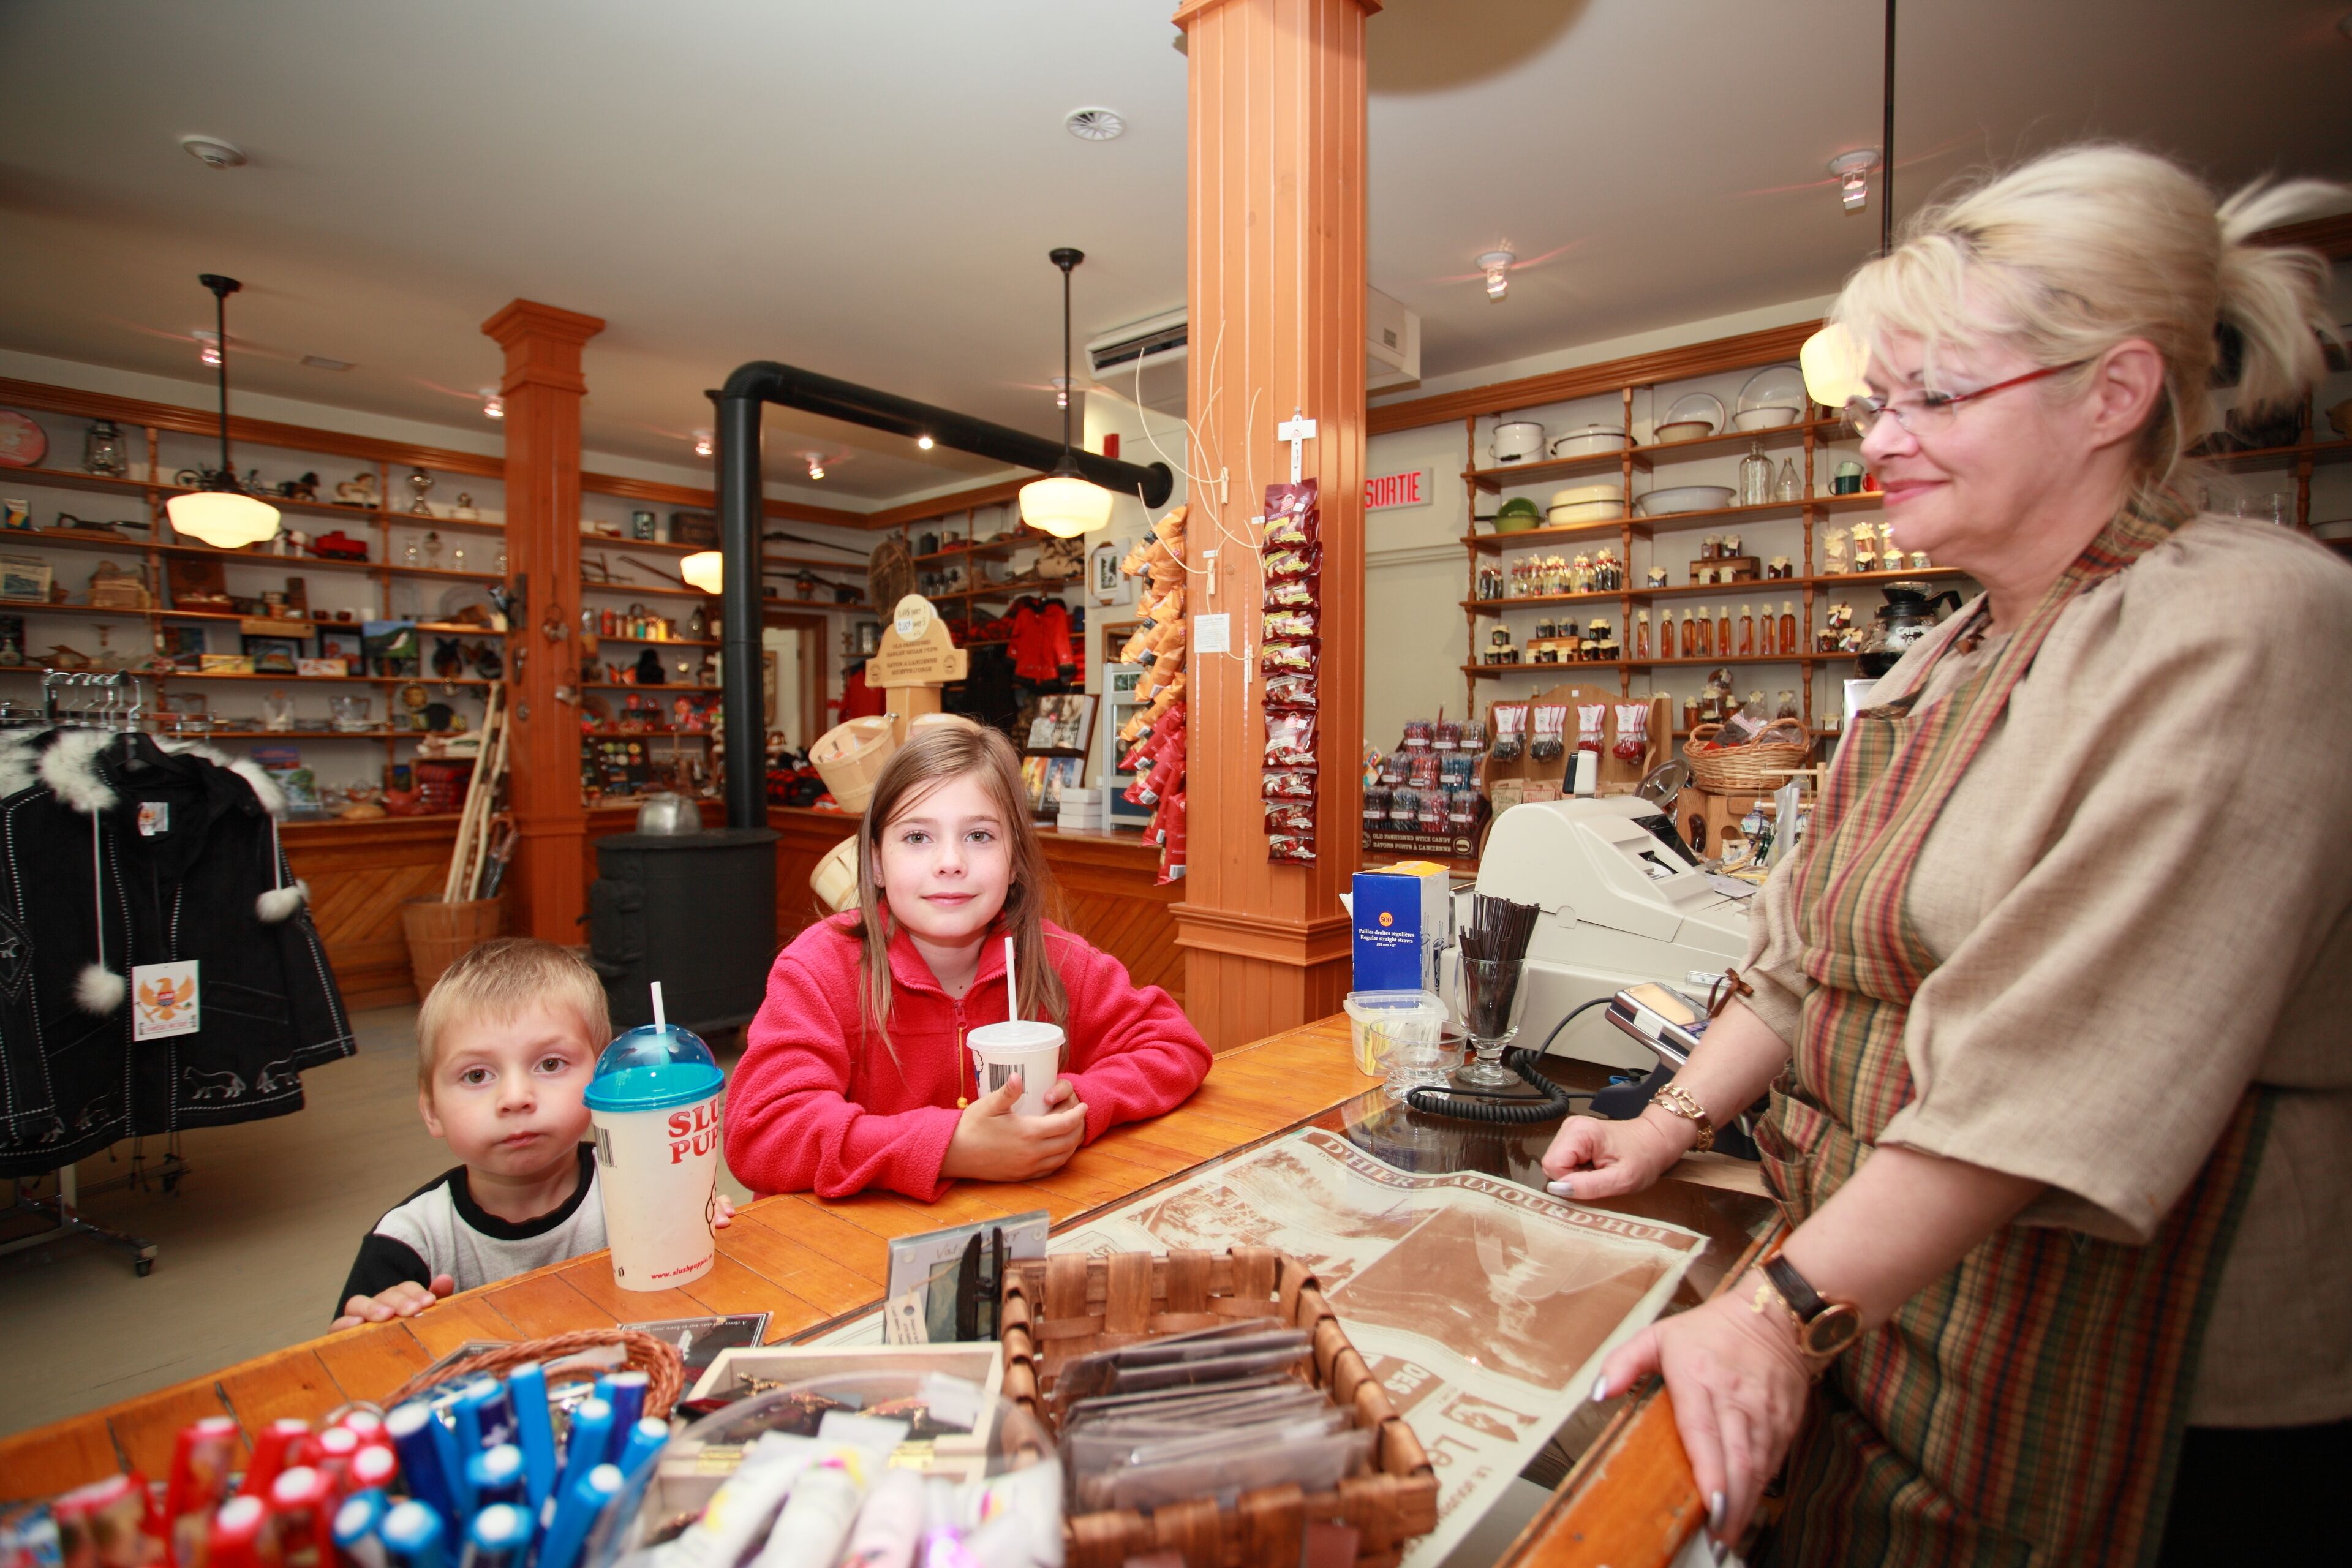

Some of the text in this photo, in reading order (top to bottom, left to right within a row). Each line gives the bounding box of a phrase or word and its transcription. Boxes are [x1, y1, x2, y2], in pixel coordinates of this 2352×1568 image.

[1364, 470, 1420, 508] SORTIE
[1317, 1152, 1341, 1169] D'une
[1343, 1167, 1377, 1188] vocation
[1319, 1138, 1415, 1188] D'HIER
[1440, 1175, 1673, 1242] AUJOURD'HUI
[1493, 1199, 1513, 1212] Vers
[1516, 1208, 1536, 1218] une
[1536, 1216, 1582, 1233] vocation
